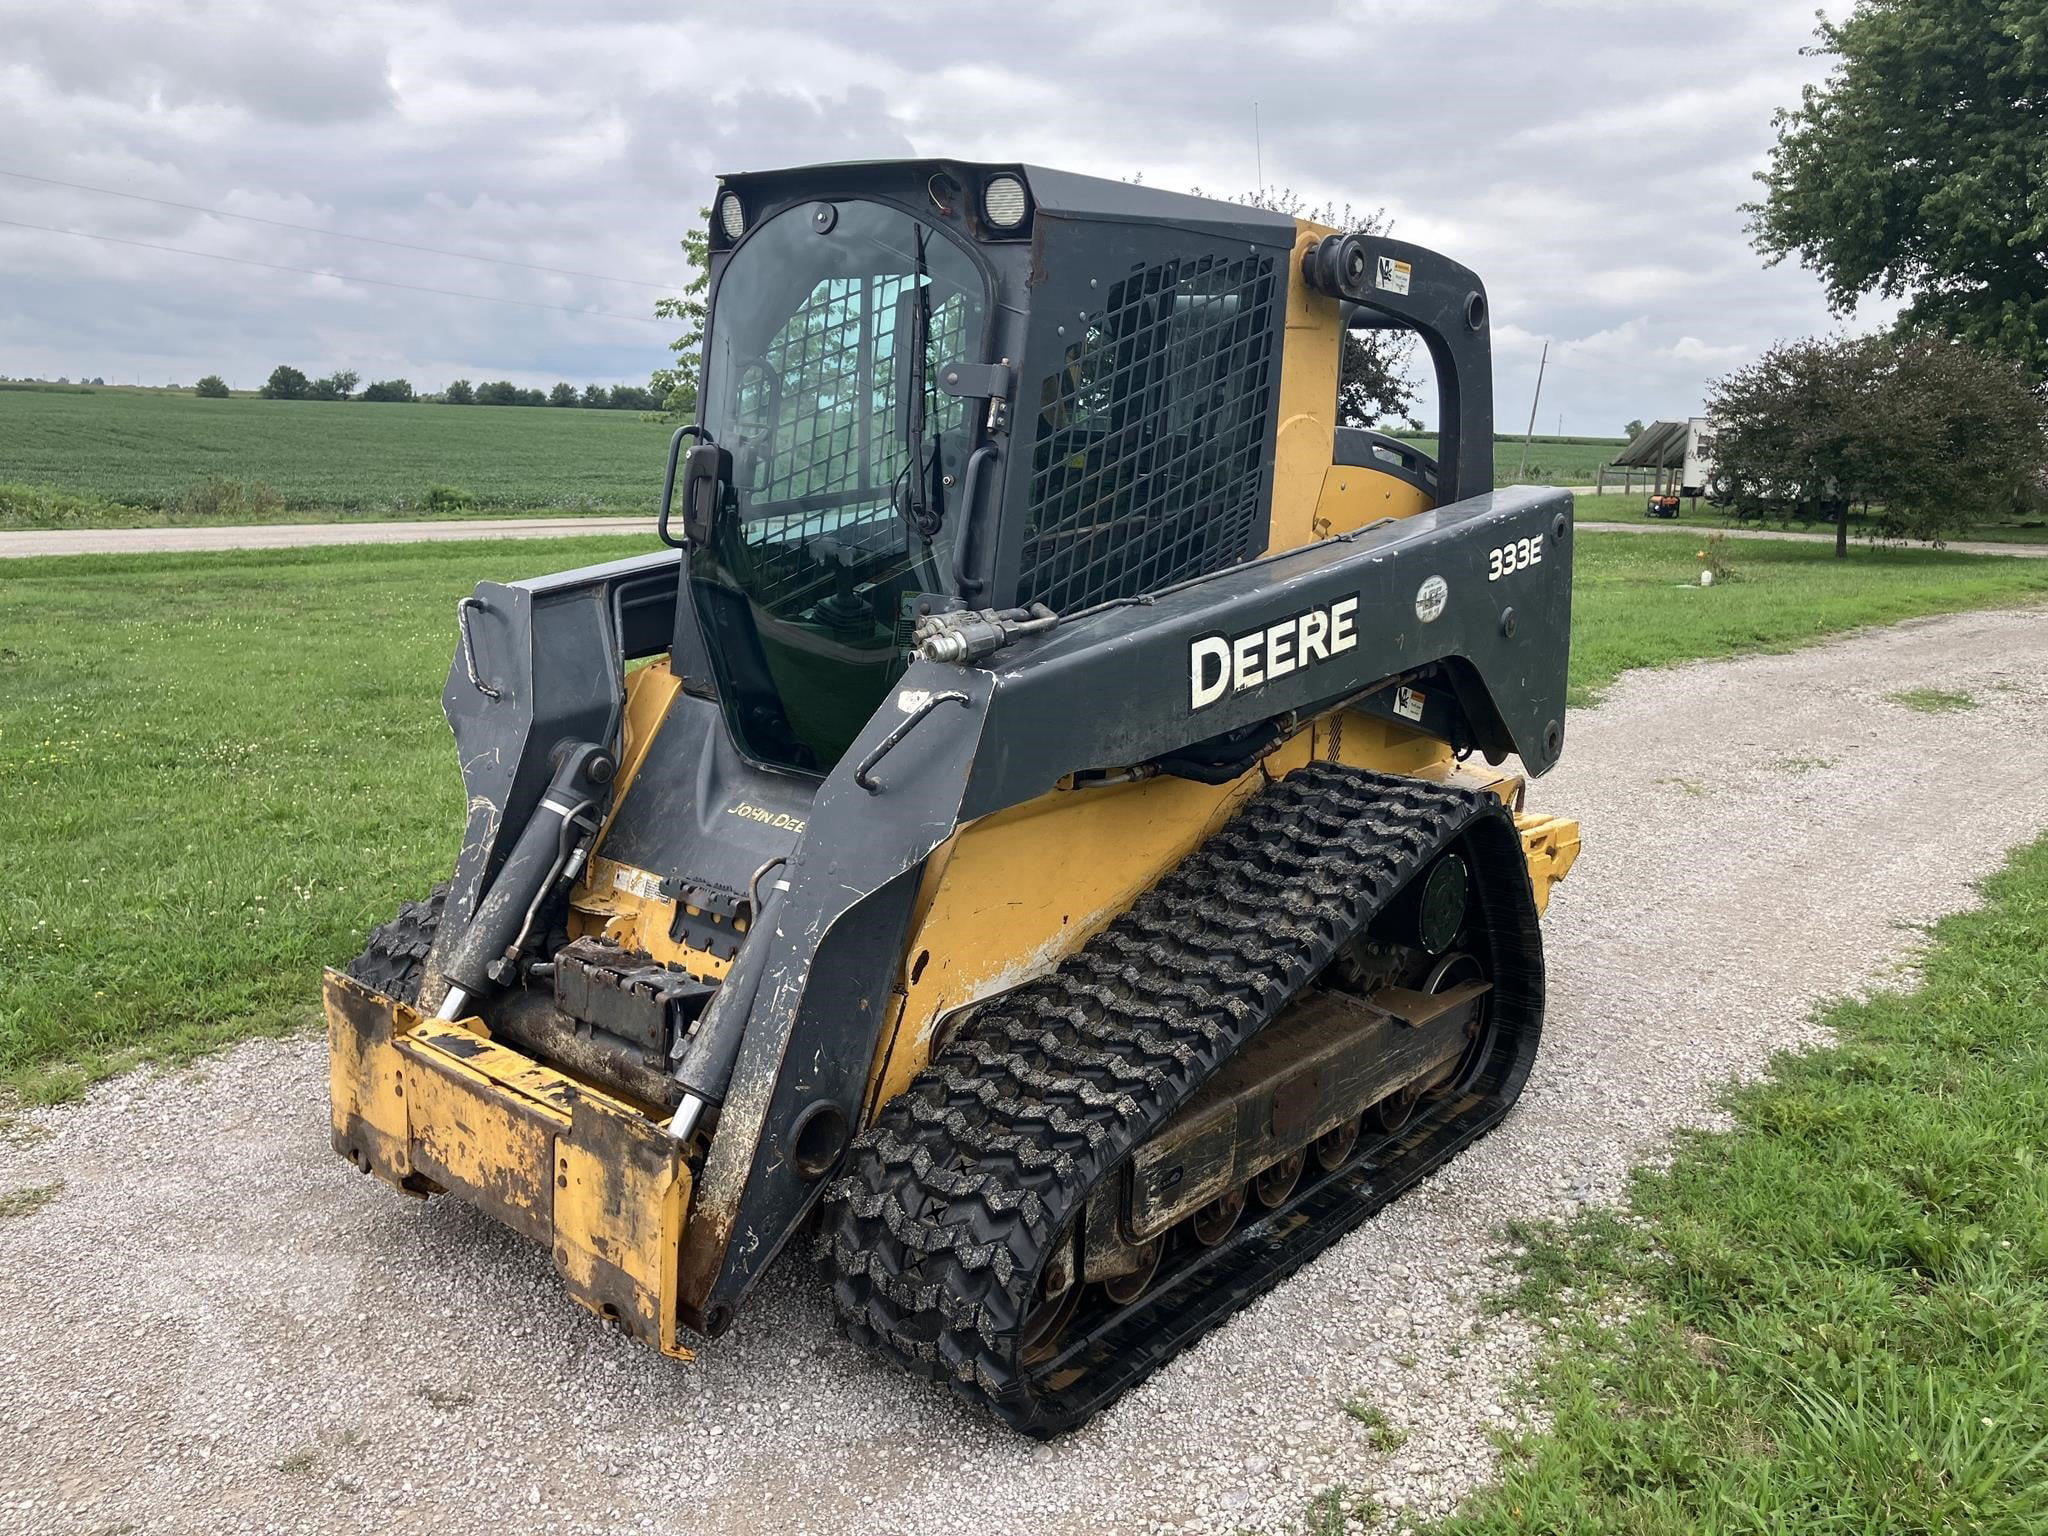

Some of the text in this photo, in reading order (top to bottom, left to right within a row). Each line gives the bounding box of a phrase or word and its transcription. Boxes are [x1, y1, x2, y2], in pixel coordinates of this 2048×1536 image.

[1488, 532, 1544, 581] 333E
[1191, 597, 1358, 710] DEERE
[727, 802, 774, 824] JOHN
